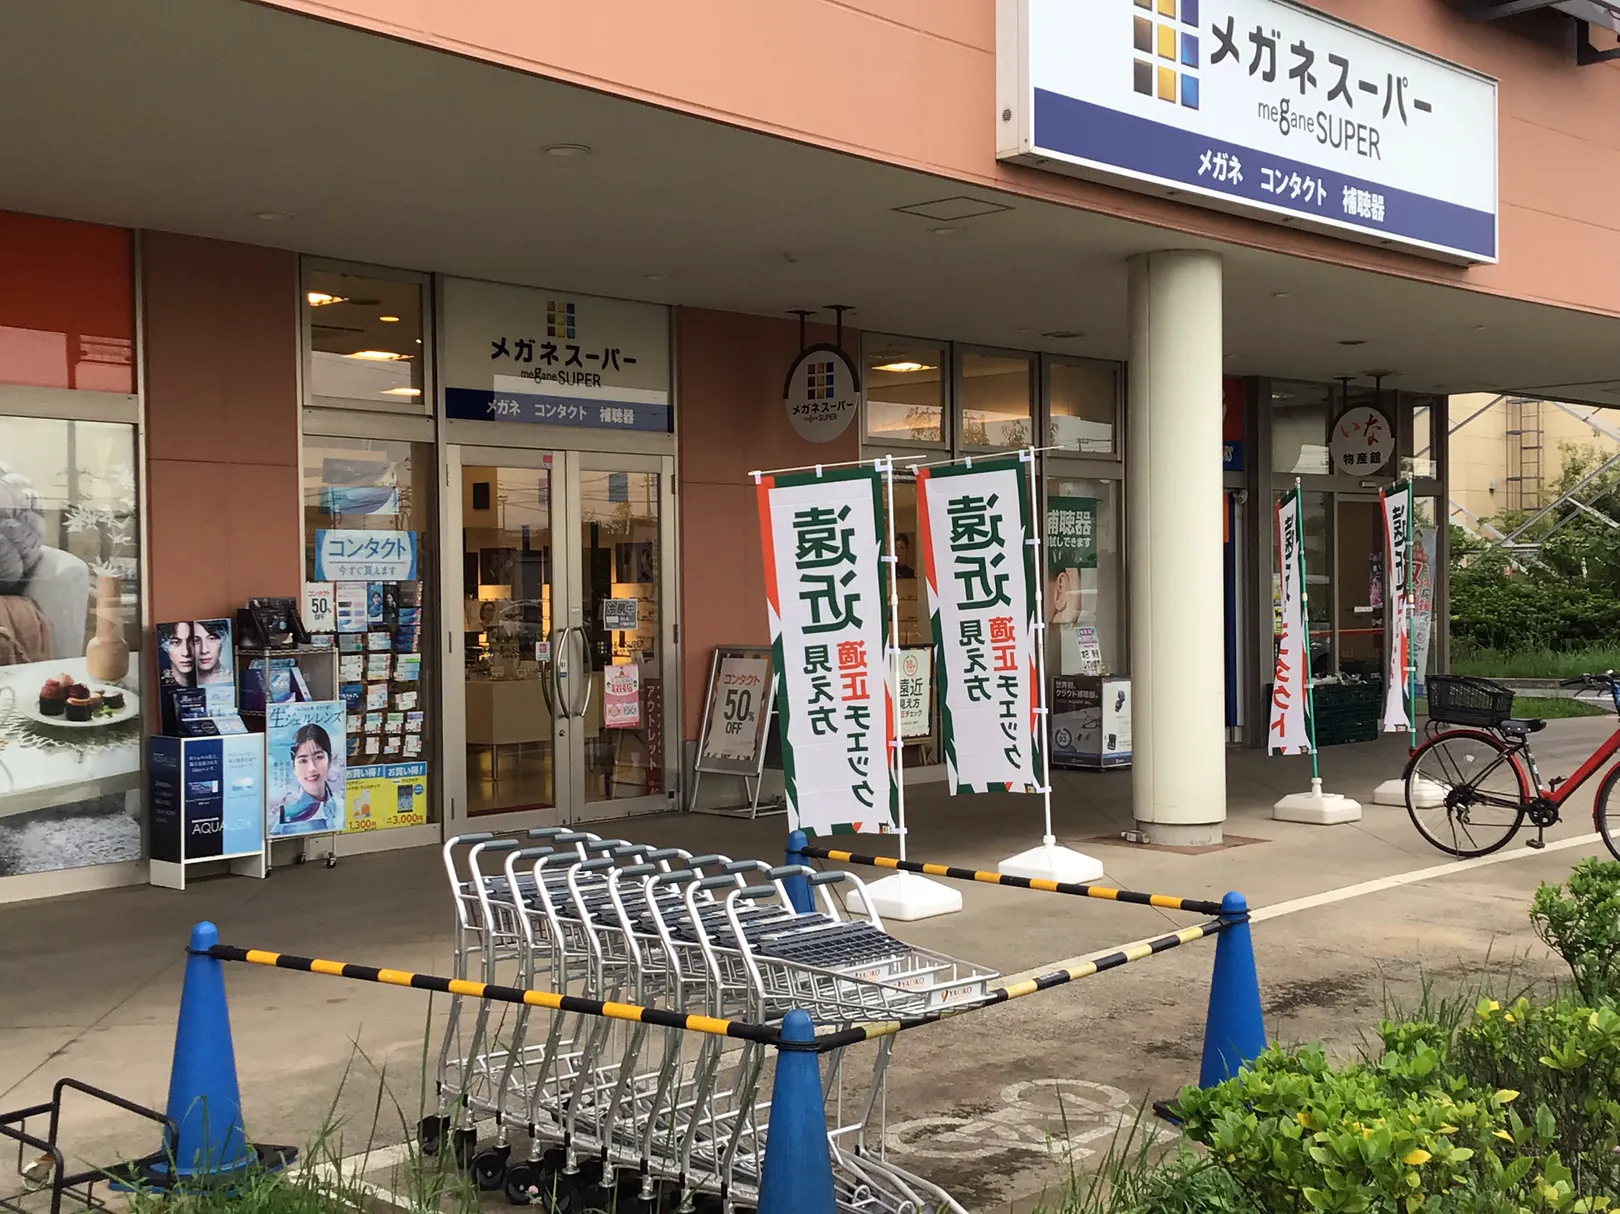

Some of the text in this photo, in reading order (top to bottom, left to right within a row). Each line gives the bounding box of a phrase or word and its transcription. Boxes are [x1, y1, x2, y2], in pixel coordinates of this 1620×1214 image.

[1210, 15, 1432, 126] メガネスーパー
[1258, 98, 1381, 160] meganeSUPER
[1198, 149, 1385, 222] メガネ コンタクト 補聴器
[491, 337, 637, 372] メガネスーパー
[521, 367, 601, 388] meganeSUPER
[486, 399, 634, 424] メガネ コンタクト 補聴器
[793, 400, 854, 416] メガネスーパー
[1343, 451, 1381, 465] 物産館
[328, 537, 406, 561] コンタクト
[338, 565, 397, 576] 今すぐ買えます
[311, 598, 332, 614] 50%
[723, 674, 760, 686] コンタクト
[723, 689, 755, 721] 50%
[268, 707, 344, 729] 生ジェルレンズ
[647, 685, 657, 771] アウトレット
[725, 721, 743, 735] OFF
[949, 986, 973, 998] YAOKO
